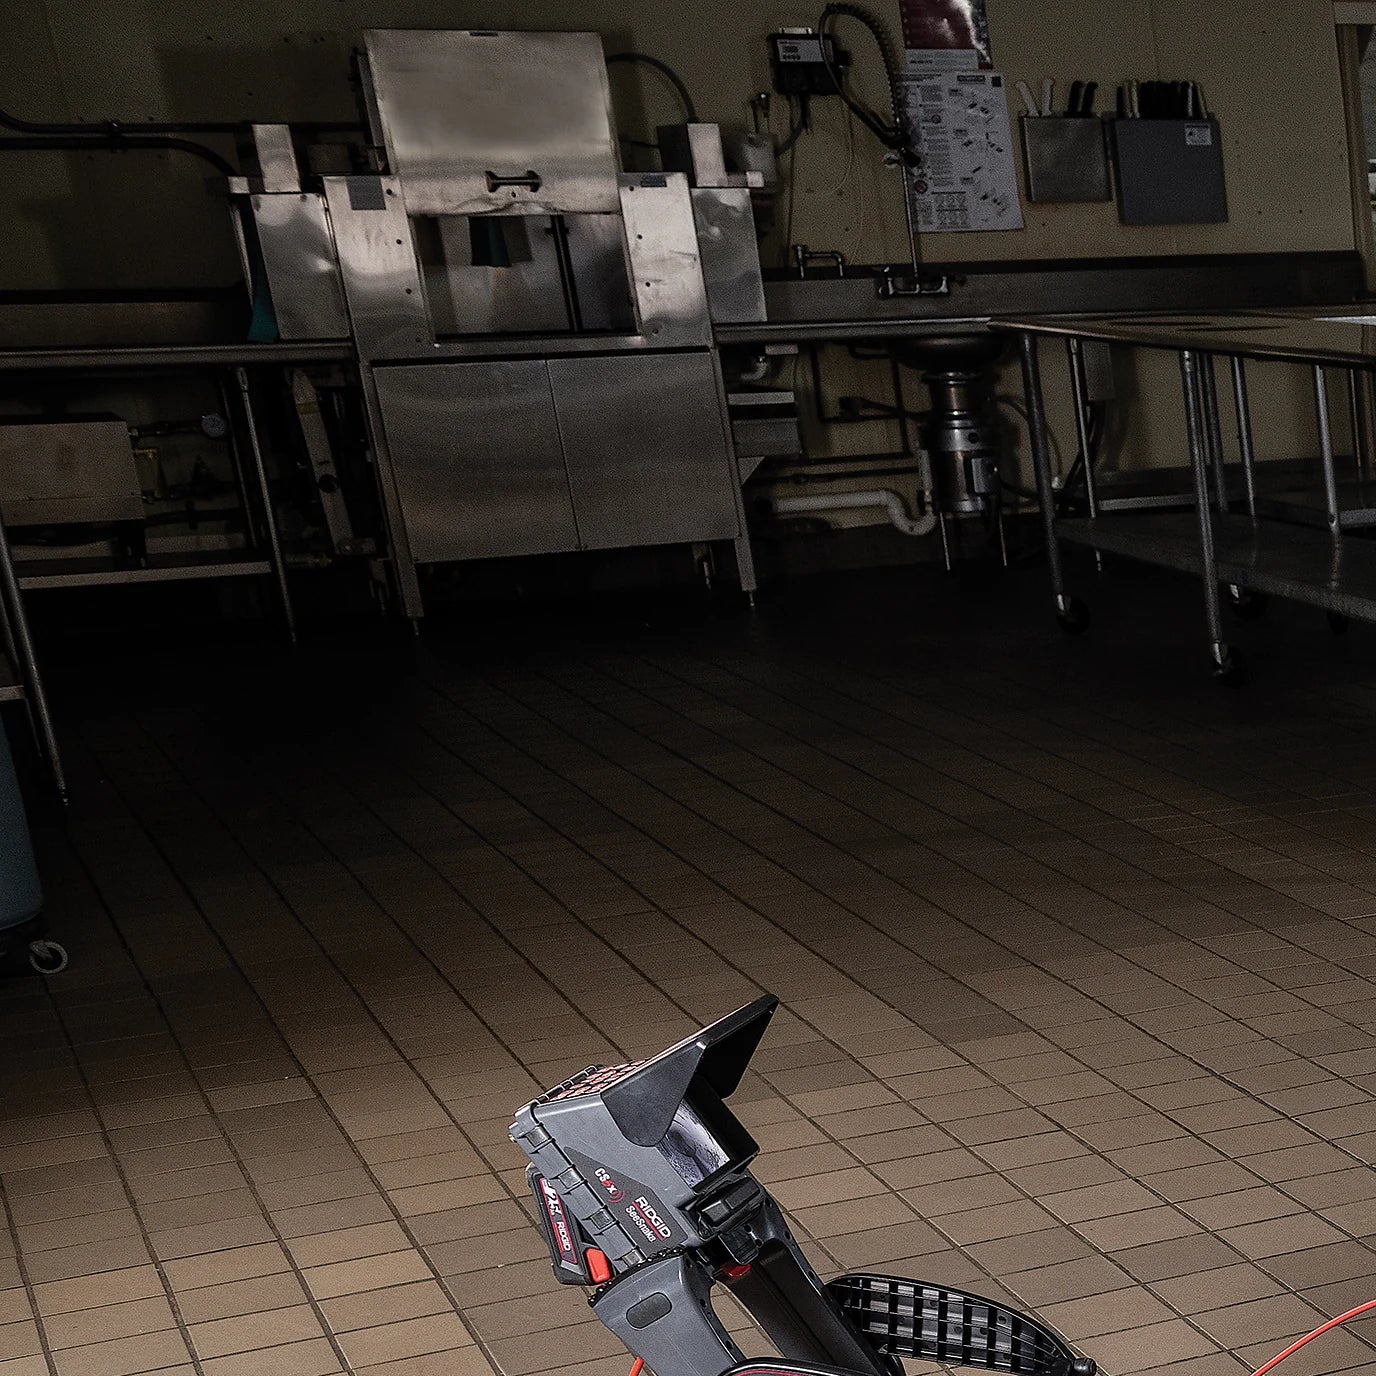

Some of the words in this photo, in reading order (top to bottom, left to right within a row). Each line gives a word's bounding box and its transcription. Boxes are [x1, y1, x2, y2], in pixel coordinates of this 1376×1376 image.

[556, 1221, 571, 1252] RIDGID
[625, 1205, 657, 1243] SeeSnake
[635, 1196, 672, 1239] RIDGID
